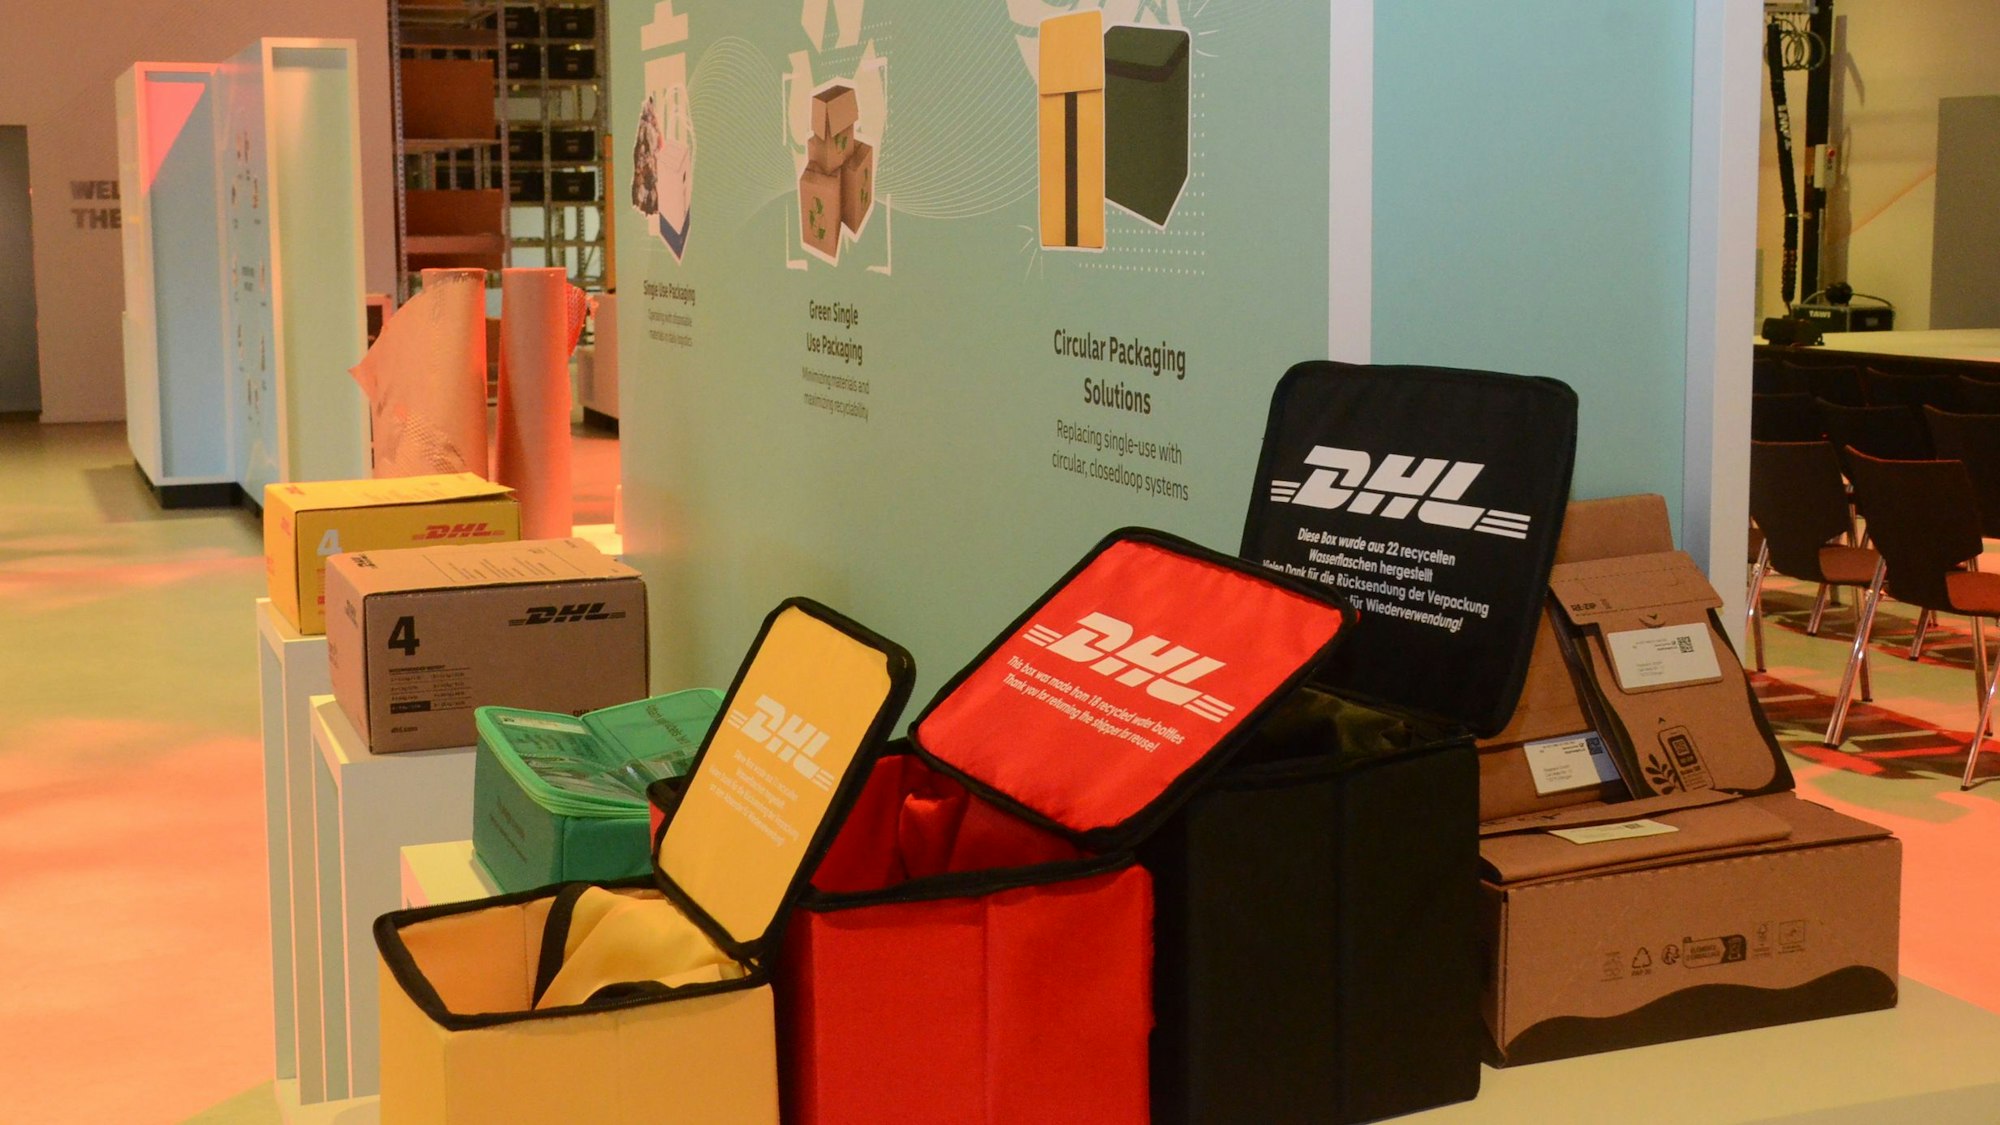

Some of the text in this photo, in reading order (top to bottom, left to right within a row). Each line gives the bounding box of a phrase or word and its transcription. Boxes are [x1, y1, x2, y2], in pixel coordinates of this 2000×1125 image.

[71, 208, 121, 229] THE
[643, 280, 696, 306] Single Use Packaging
[810, 300, 858, 330] Green Single
[806, 332, 862, 366] Use Packaging
[1054, 329, 1186, 380] Circular Packaging
[802, 366, 870, 394] Minimizing materials and
[1084, 377, 1151, 415] Solutions
[804, 393, 869, 421] maximizing recyclability
[1057, 419, 1182, 466] Replacing single-use with
[1052, 450, 1189, 501] circular, closedloop systems
[1292, 445, 1486, 530] DHL
[316, 528, 344, 556] 4
[426, 523, 492, 540] DHL
[1298, 528, 1456, 566] Diese Box wurde aus 22 recycelten
[1308, 549, 1433, 582] Wasserflaschen hergestellt
[1308, 567, 1320, 580] für
[1320, 570, 1335, 584] die
[1336, 573, 1406, 600] Rücksendung
[1408, 583, 1425, 602] der
[1427, 590, 1490, 618] Verpackung
[524, 602, 610, 625] DHL
[1350, 595, 1464, 633] für Wiederverwendung!
[388, 616, 420, 656] 4
[1046, 612, 1227, 706] DHL
[1003, 672, 1028, 692] Thank
[1021, 686, 1040, 696] you
[1036, 689, 1050, 702] for
[1046, 696, 1082, 720] returning
[1078, 710, 1094, 724] the
[1091, 718, 1122, 735] shipper
[1128, 733, 1160, 753] reuse!
[1008, 655, 1024, 670] This
[1020, 662, 1038, 676] box
[1034, 671, 1052, 684] was
[1048, 678, 1072, 694] made
[1069, 686, 1090, 702] from
[1096, 701, 1137, 722] recycled
[1131, 717, 1156, 728] water
[1152, 720, 1185, 745] bottles
[740, 694, 830, 780] DHL
